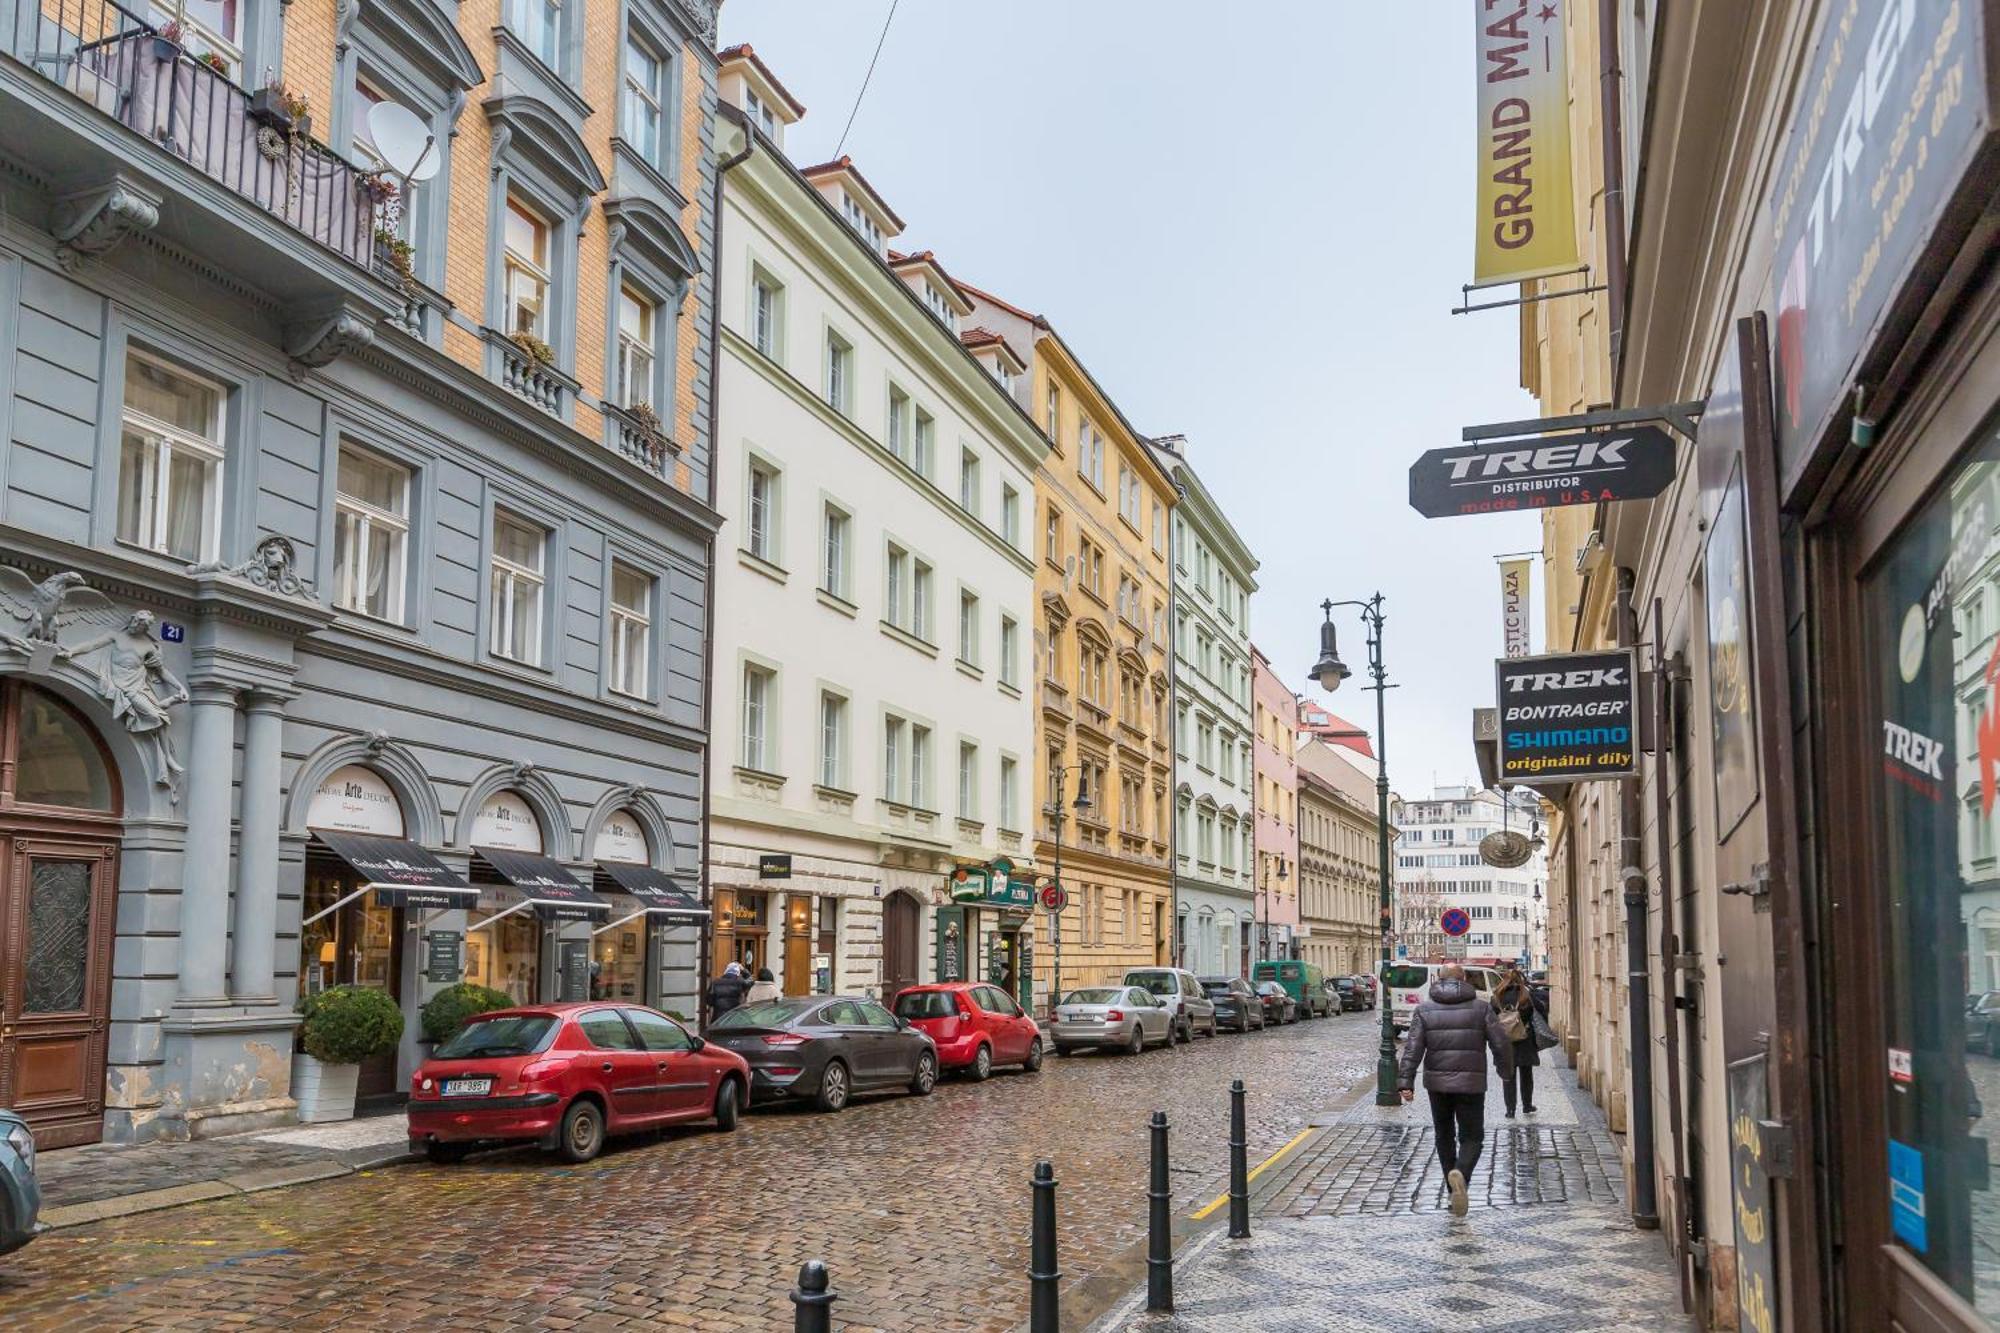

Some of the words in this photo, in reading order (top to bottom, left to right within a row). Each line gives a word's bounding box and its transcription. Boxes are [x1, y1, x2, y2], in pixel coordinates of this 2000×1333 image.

[1485, 0, 1530, 83] MA
[1492, 97, 1534, 250] GRAND
[1442, 438, 1634, 479] TREK
[1493, 477, 1580, 494] DISTRIBUTOR
[1461, 498, 1518, 513] made
[1529, 495, 1546, 508] in
[1561, 489, 1620, 505] U.S.A.
[1505, 570, 1520, 613] PLAZA
[167, 626, 180, 639] 21
[1506, 701, 1625, 721] BONTRAGER
[1508, 727, 1629, 749] SHIMANO
[1506, 752, 1592, 771] originální
[1598, 752, 1632, 767] díly
[1883, 720, 1945, 781] TREK
[345, 782, 362, 799] Arte
